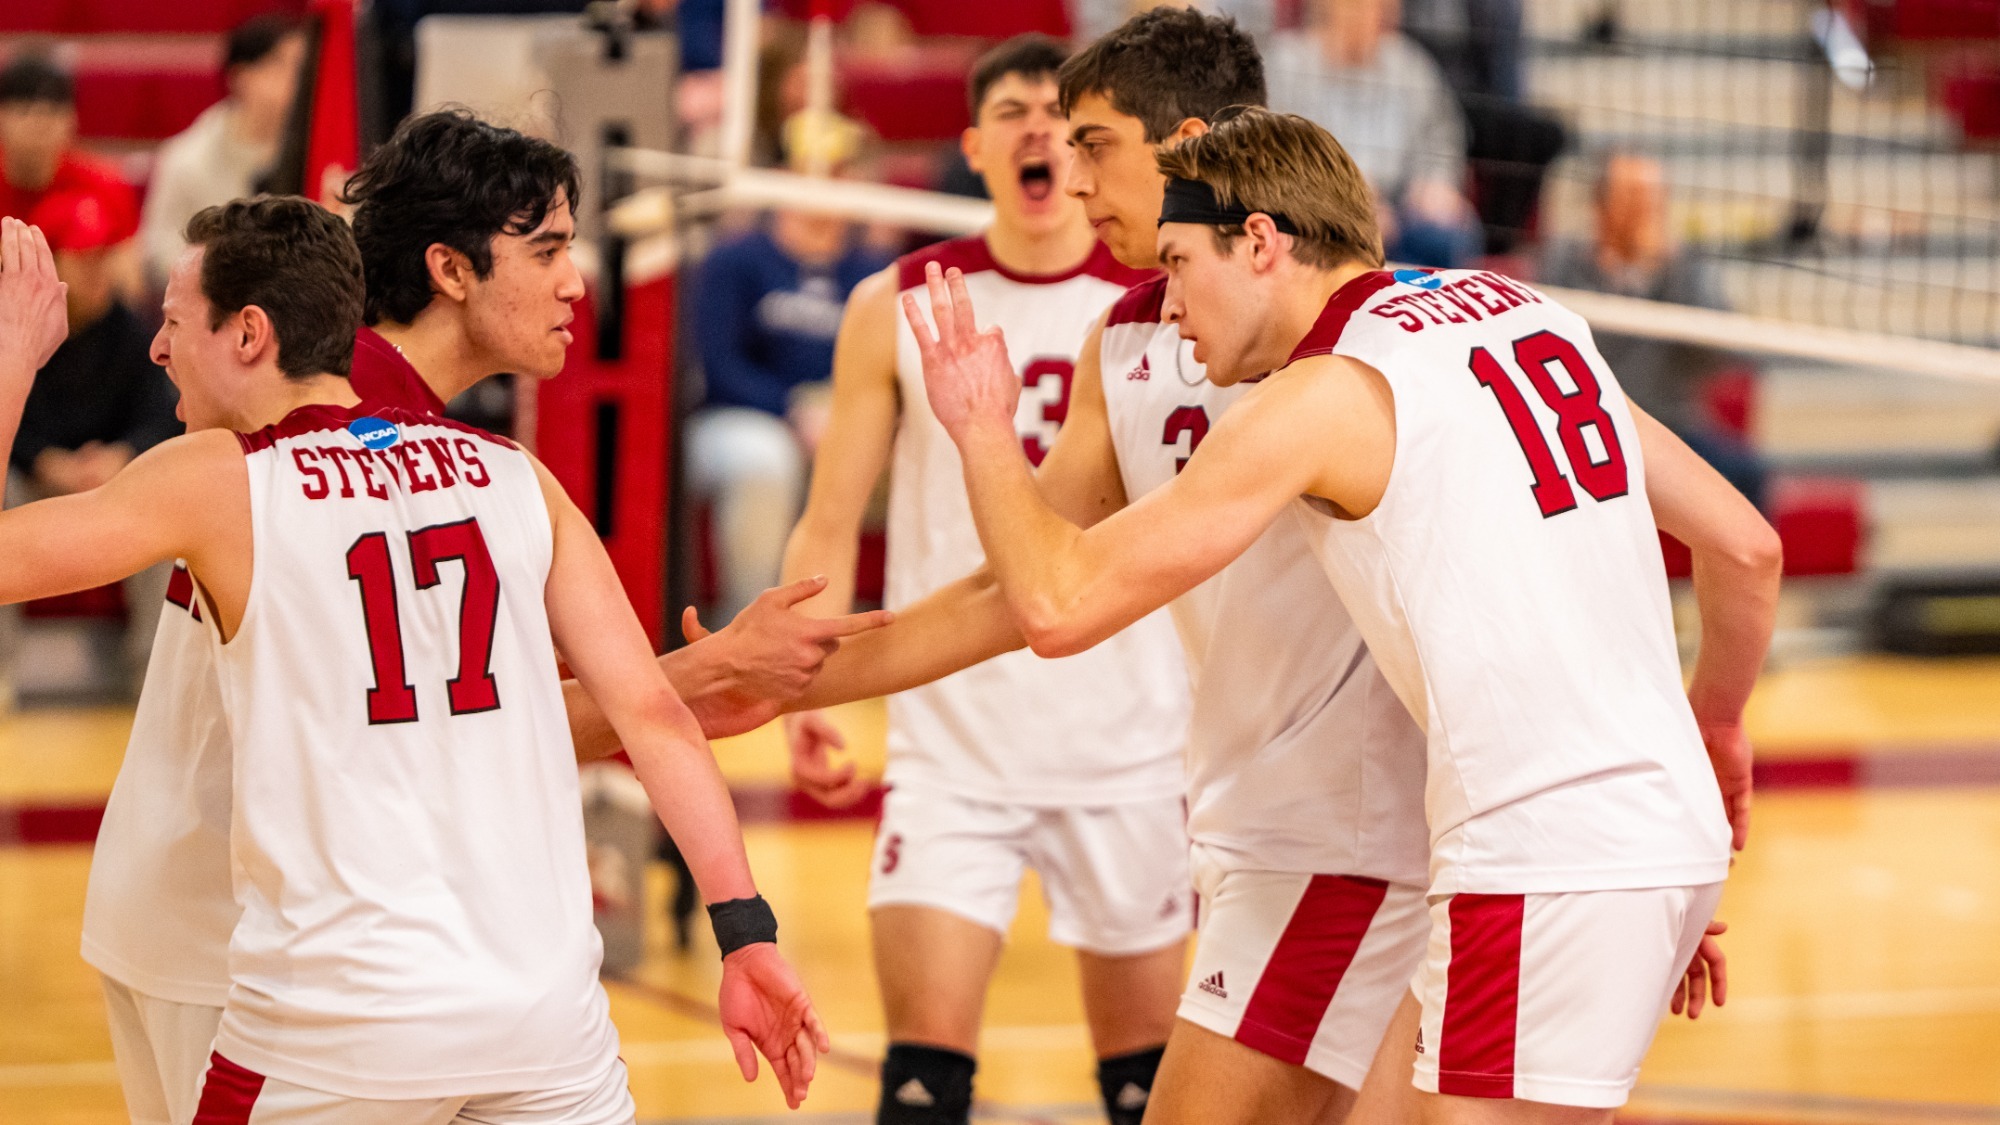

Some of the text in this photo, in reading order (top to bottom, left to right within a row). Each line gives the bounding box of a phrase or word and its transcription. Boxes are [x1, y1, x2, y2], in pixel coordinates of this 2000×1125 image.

[292, 437, 491, 500] STEVENS
[357, 426, 397, 443] NCAA
[1468, 329, 1629, 519] 18
[346, 516, 501, 725] 17
